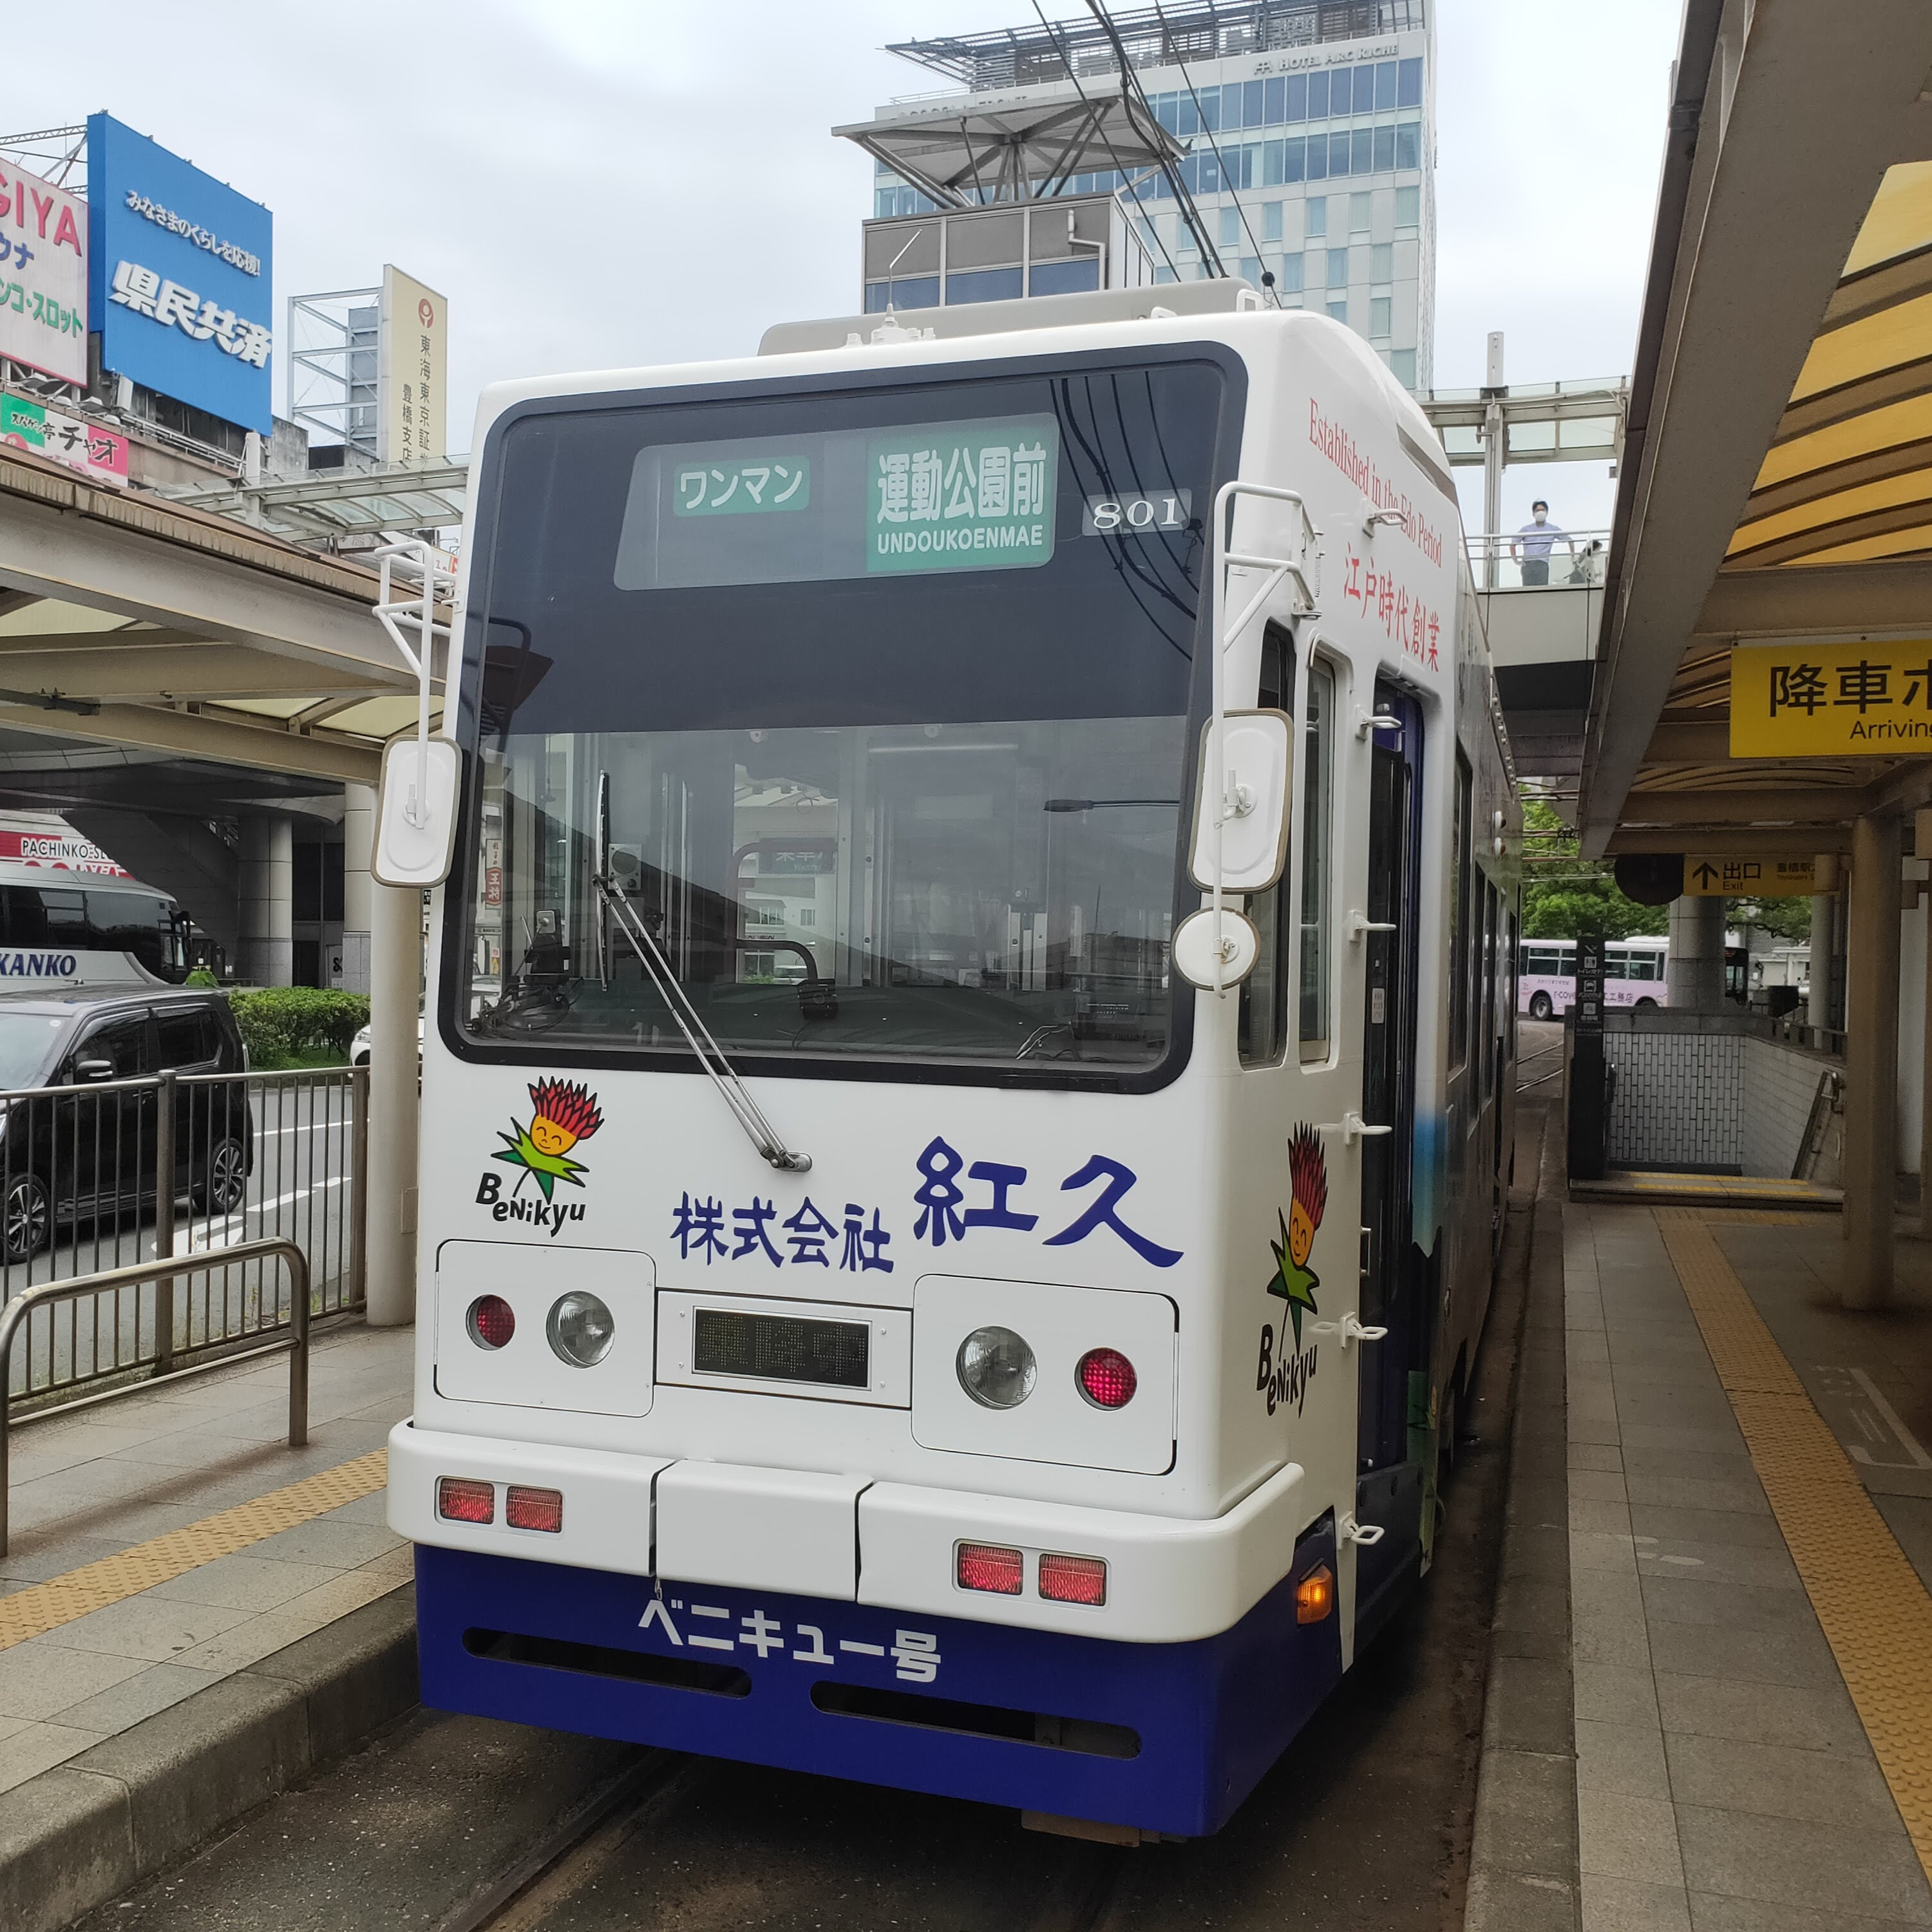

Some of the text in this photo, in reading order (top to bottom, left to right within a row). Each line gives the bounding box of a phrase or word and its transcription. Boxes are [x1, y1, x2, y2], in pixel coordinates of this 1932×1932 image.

[1279, 57, 1321, 71] HOTEL
[108, 260, 272, 369] 県民共済
[679, 465, 802, 509] ワンマン
[877, 442, 1046, 523] 運動公園前
[1309, 397, 1369, 497] Established
[1372, 463, 1381, 507] in
[1418, 512, 1442, 569] Period
[1093, 498, 1180, 530] 801
[877, 525, 1043, 555] UNDOUKOENMAE
[1850, 719, 1932, 740] Arrivin
[23, 840, 88, 858] PACHINKO
[1723, 862, 1761, 880] 出口
[1723, 881, 1743, 891] Exit
[670, 1135, 1184, 1273] 株式会社 紅久
[638, 1598, 942, 1683] ベニキュー号
